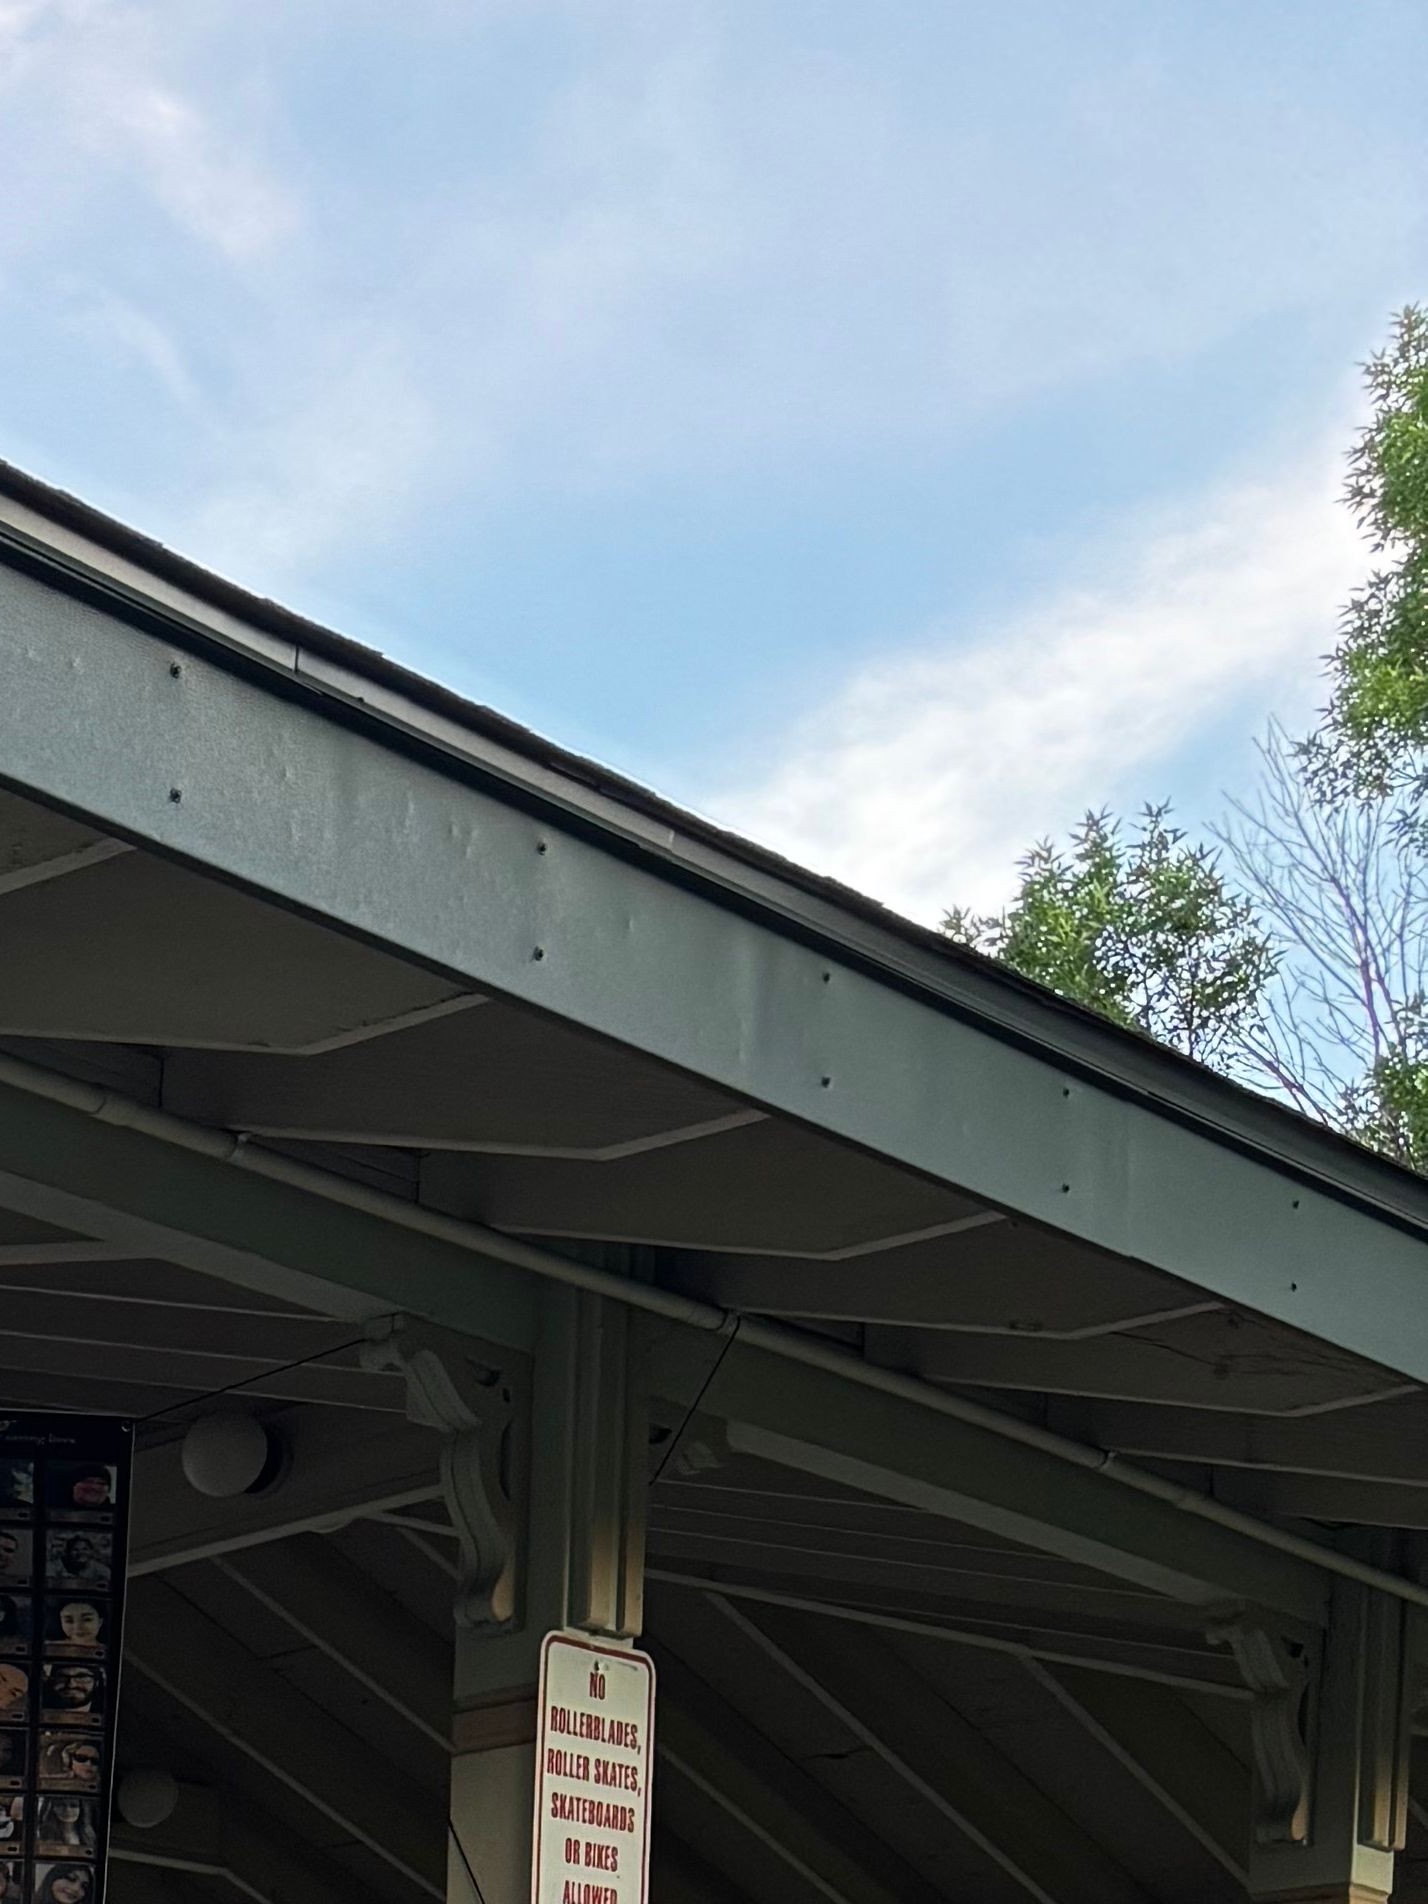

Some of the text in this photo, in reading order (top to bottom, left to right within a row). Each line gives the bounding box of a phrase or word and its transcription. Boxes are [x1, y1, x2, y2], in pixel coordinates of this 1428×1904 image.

[589, 1672, 605, 1700] NO
[550, 1706, 642, 1754] ROLLERBLADES,
[547, 1748, 642, 1797] ROLLER SKATES,
[551, 1792, 635, 1833] SKATEBOARDS
[565, 1838, 618, 1873] OR BIKES
